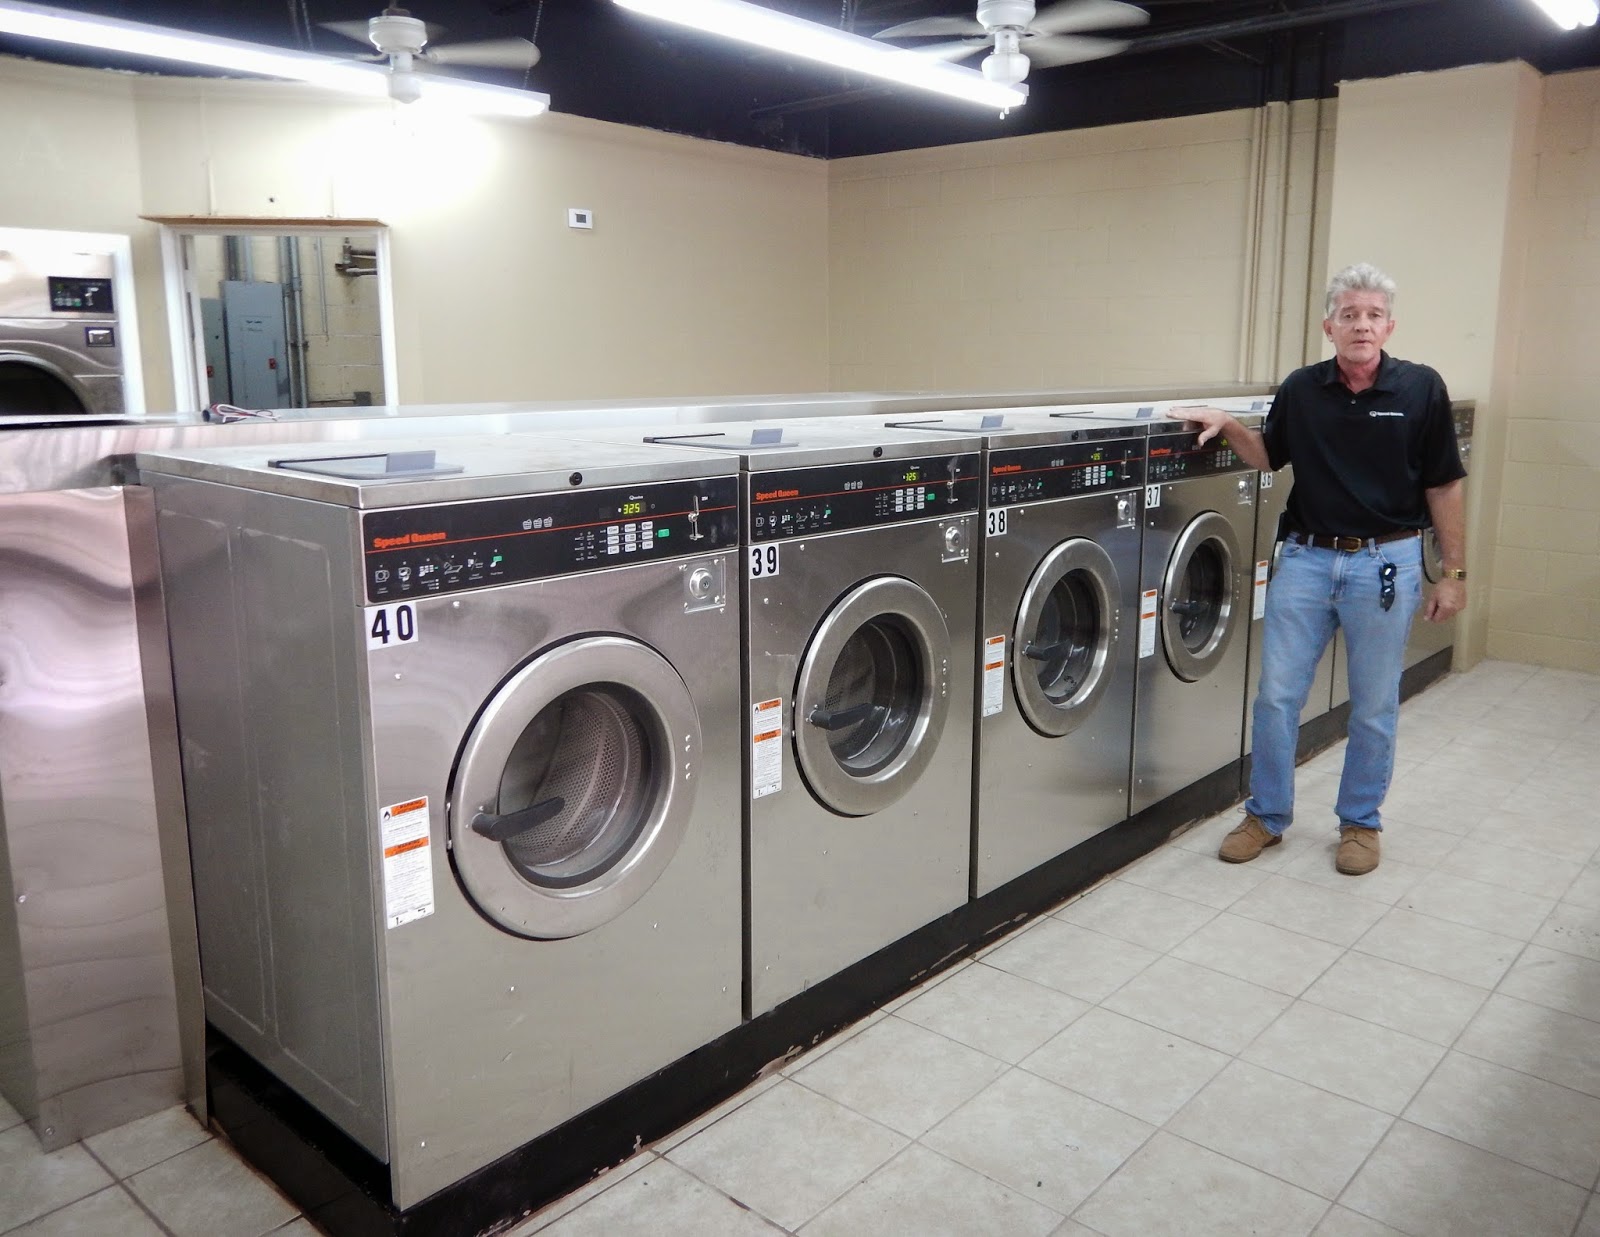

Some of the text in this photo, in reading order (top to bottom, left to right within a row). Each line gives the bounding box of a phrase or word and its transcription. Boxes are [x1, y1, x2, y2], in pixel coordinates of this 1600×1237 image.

[756, 490, 799, 501] Speed Queen
[1147, 486, 1159, 506] 37
[623, 502, 640, 515] 325
[988, 510, 1005, 535] 38
[373, 532, 446, 549] Speed Queen
[752, 546, 777, 576] 39
[371, 605, 414, 645] 40
